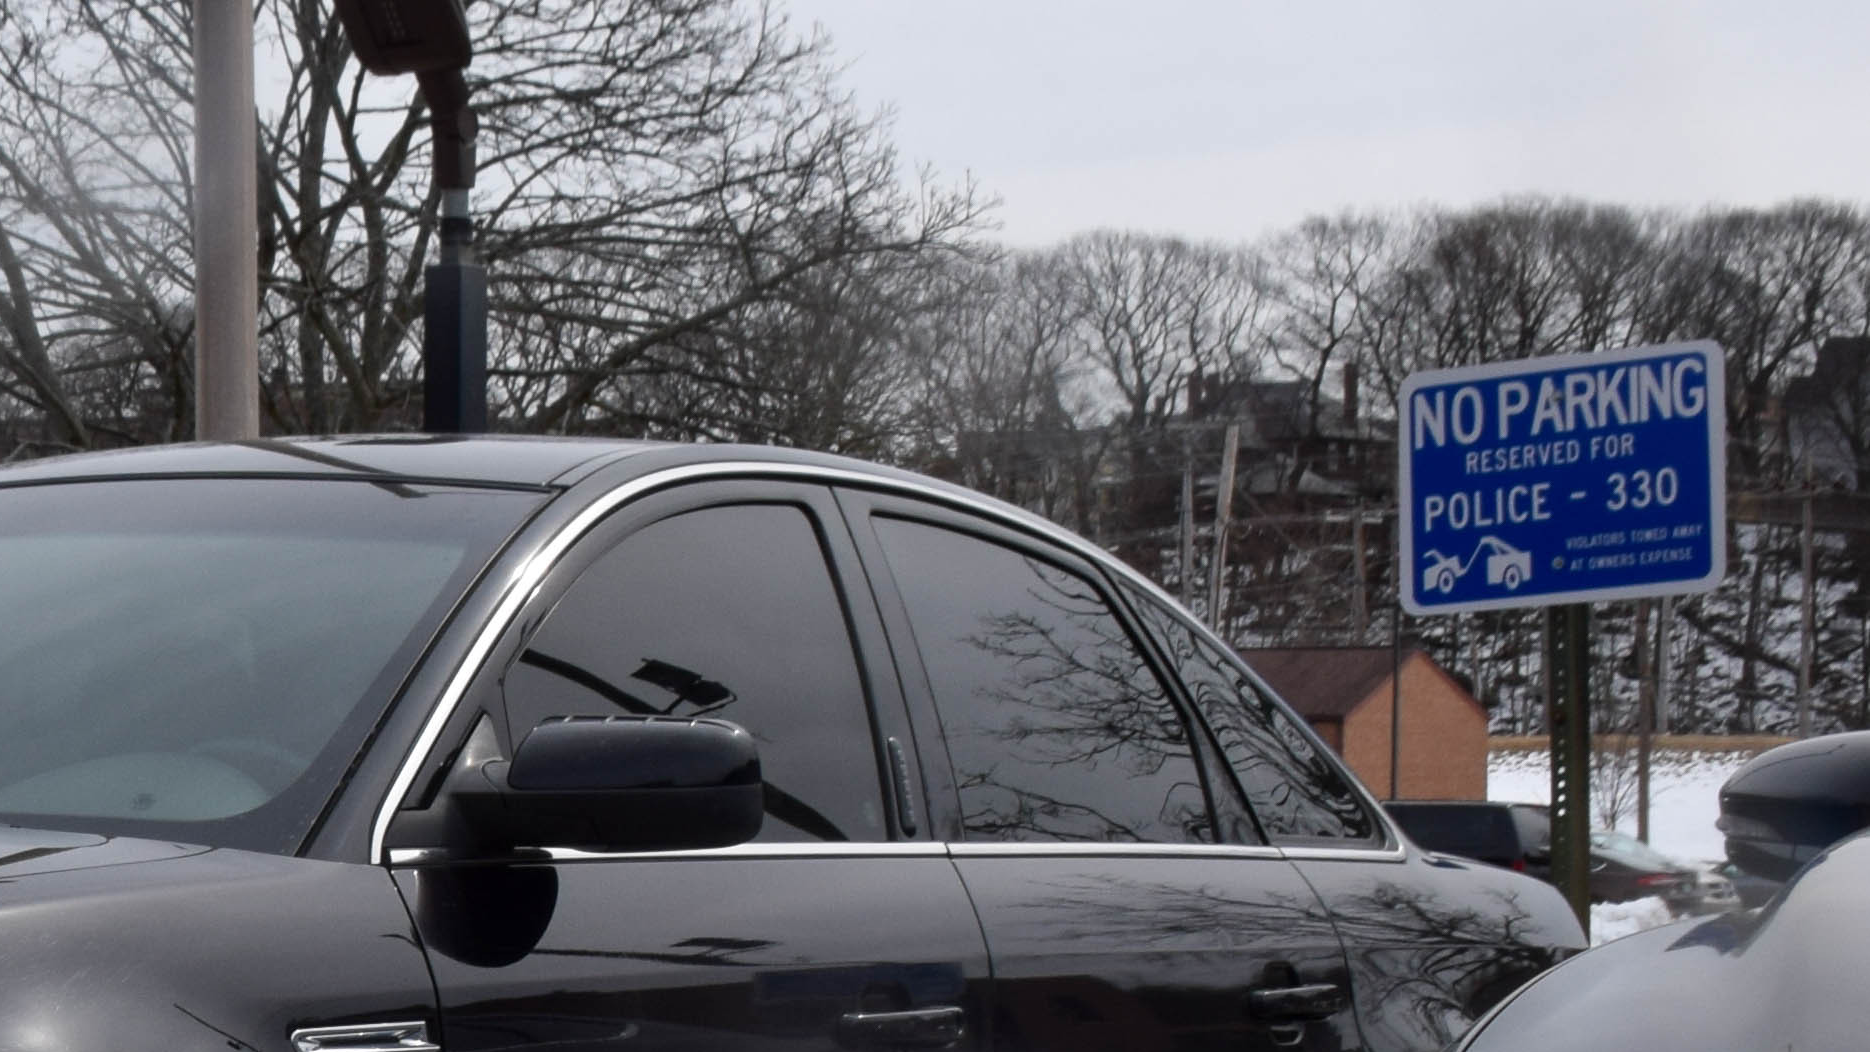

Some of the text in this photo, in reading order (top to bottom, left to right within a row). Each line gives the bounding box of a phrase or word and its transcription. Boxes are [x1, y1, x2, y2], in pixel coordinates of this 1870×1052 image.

[1414, 358, 1706, 449] NO PARKING
[1466, 434, 1635, 475] RESERVED FOR
[1425, 483, 1552, 532] POLICE
[1606, 467, 1679, 511] 330
[1566, 524, 1703, 550] VIOLATORS TOWED AWAY
[1570, 548, 1694, 572] AT OWNERS EXPENSE
